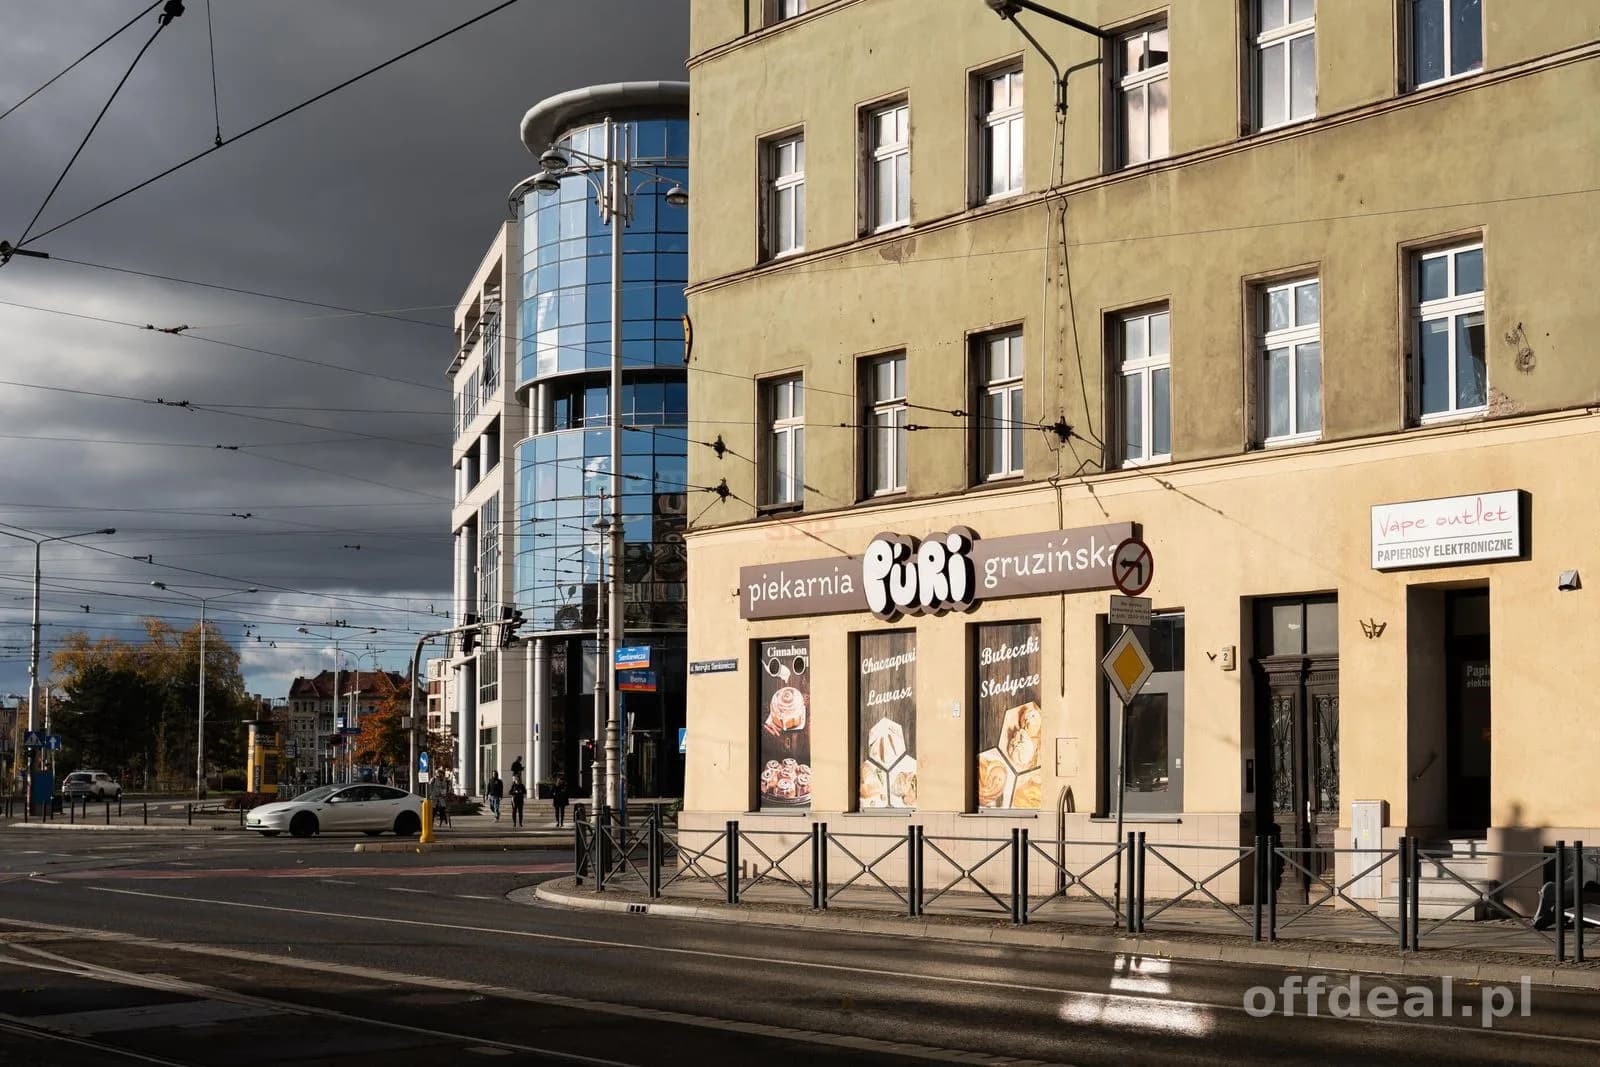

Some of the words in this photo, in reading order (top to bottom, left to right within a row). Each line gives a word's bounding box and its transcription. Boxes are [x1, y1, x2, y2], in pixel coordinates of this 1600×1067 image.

[1379, 513, 1427, 537] Vape
[1436, 496, 1512, 527] outlet
[1377, 546, 1431, 562] PAPIEROSY
[1434, 538, 1513, 557] ELEKTRONICZNE
[748, 566, 855, 612] piekarnia
[767, 645, 807, 658] Cinnabon
[861, 648, 917, 675] Chaczapuri
[1466, 664, 1491, 679] Papi
